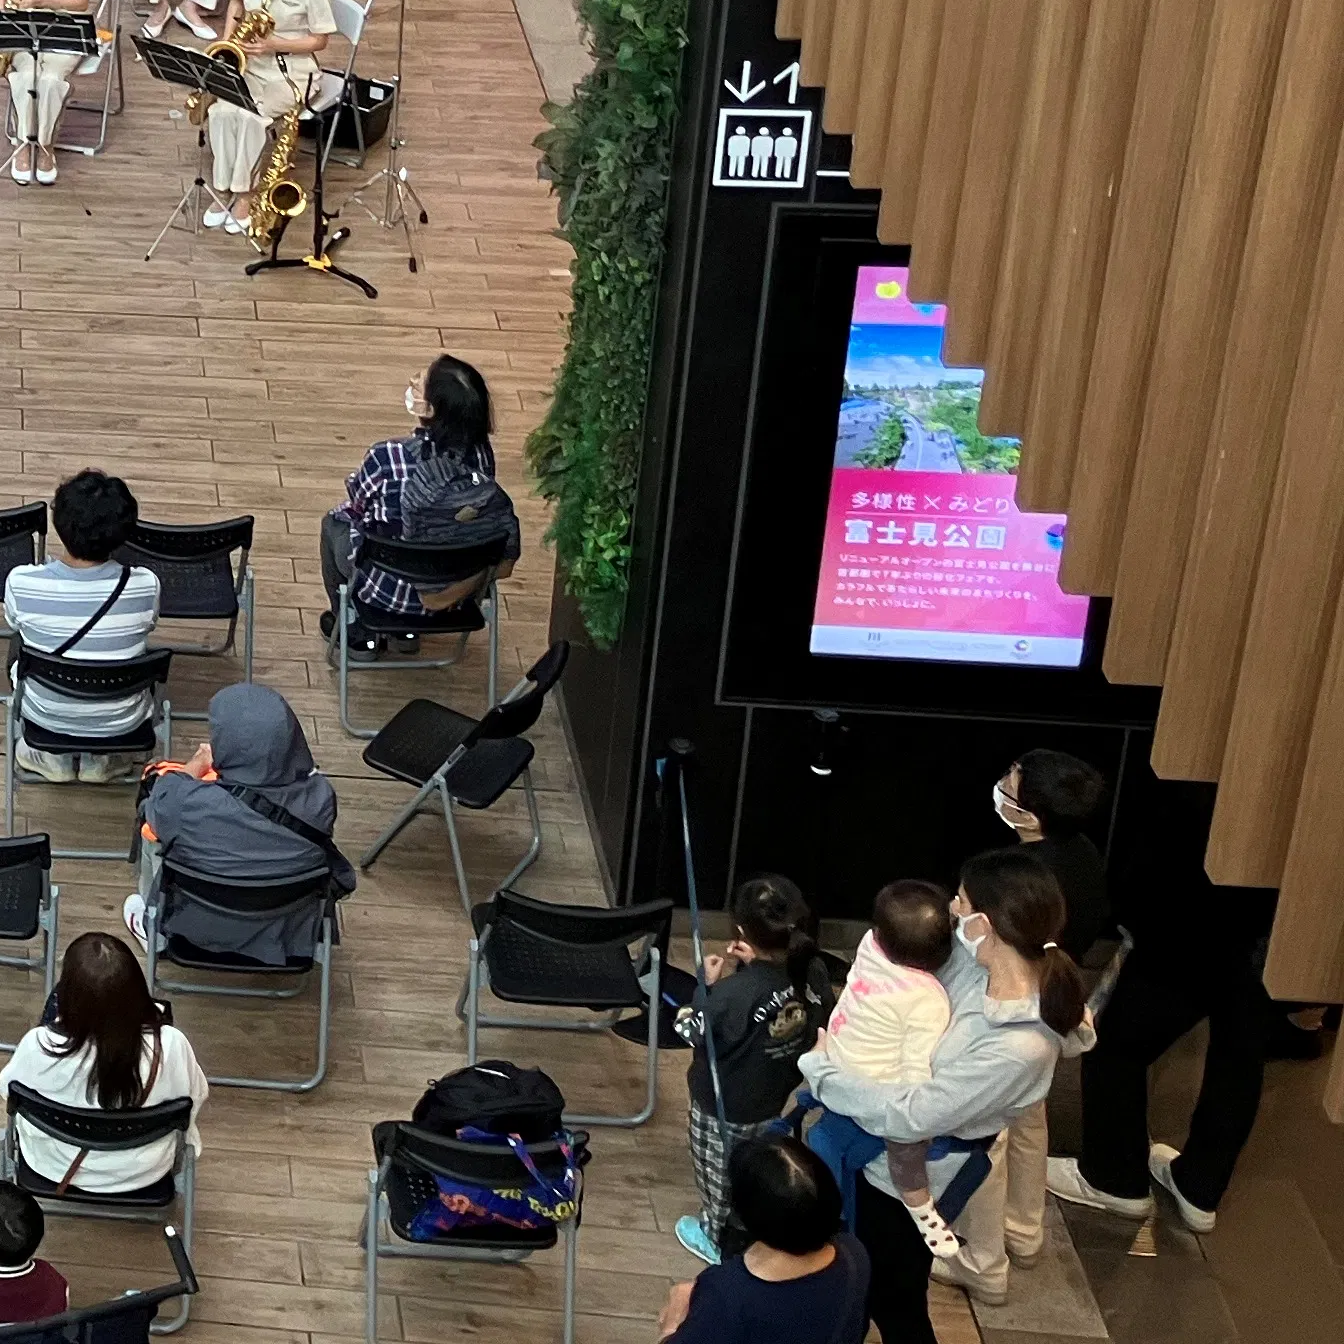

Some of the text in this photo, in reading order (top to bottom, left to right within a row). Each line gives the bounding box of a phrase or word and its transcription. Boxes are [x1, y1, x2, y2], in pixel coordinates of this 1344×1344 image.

[844, 518, 1008, 551] 富士見公園
